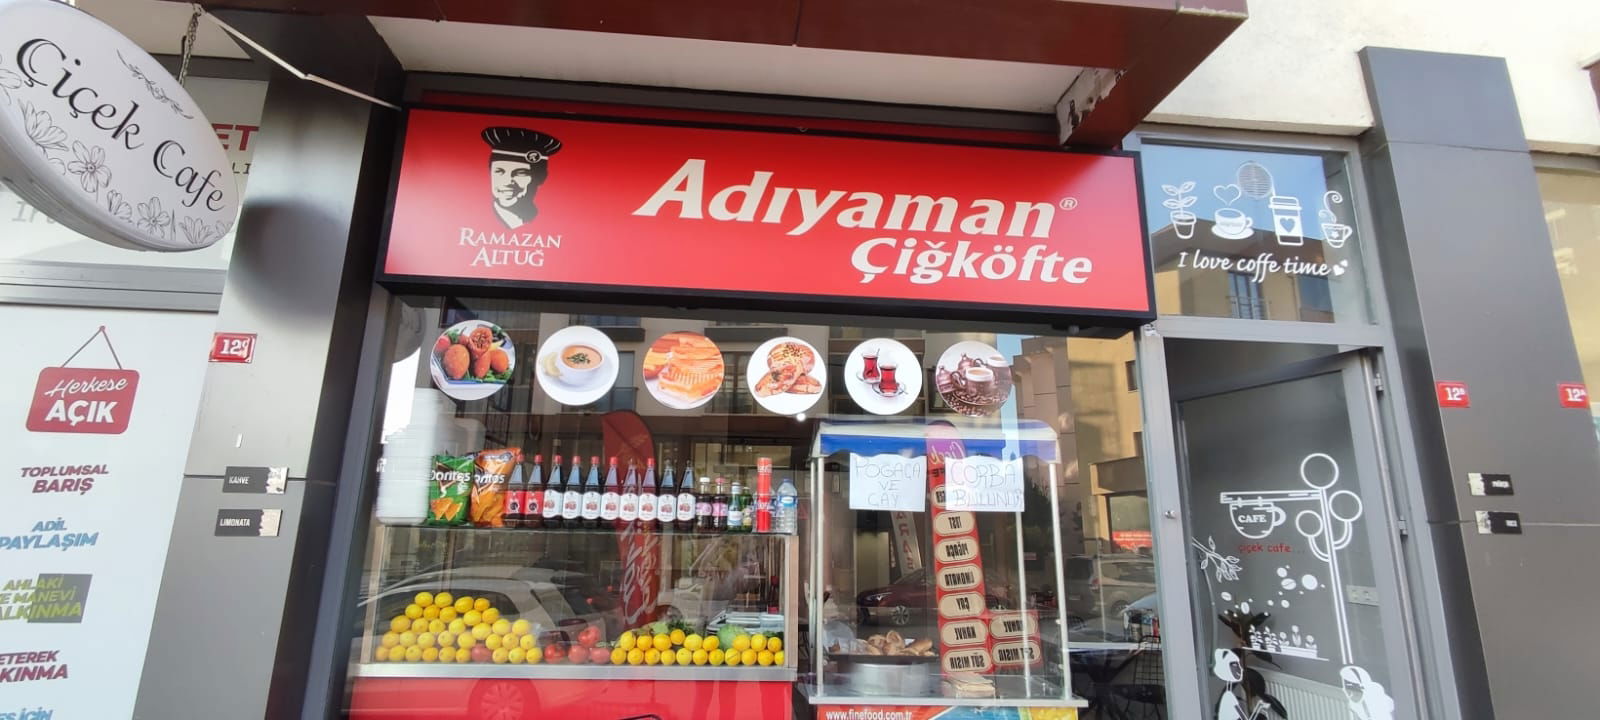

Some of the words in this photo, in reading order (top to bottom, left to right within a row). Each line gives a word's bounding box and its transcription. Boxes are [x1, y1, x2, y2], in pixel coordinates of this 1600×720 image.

[17, 38, 145, 151] Çiçek
[153, 139, 225, 212] Cafe
[631, 158, 1055, 238] Adıyaman
[458, 227, 562, 249] RAMAZAN
[470, 247, 545, 268] ALTUĞ
[850, 236, 1093, 285] Çiğköfte
[1177, 251, 1189, 268] I
[1192, 249, 1234, 271] love
[1236, 252, 1281, 283] coffe
[1282, 255, 1332, 276] time
[44, 376, 129, 399] Herkese
[44, 399, 118, 427] AÇIK
[20, 464, 110, 478] TOPLUMSAL
[228, 475, 250, 485] KAHVE
[474, 474, 505, 484] oritos
[32, 477, 95, 496] BARIŞ
[31, 517, 67, 532] ADİL
[1238, 514, 1267, 523] CAFE
[0, 531, 99, 551] PAYLAŞIM
[3, 574, 64, 591] AHLAKİ
[13, 585, 77, 604] MANEVİ
[826, 709, 912, 720] www.finefood.com.tr
